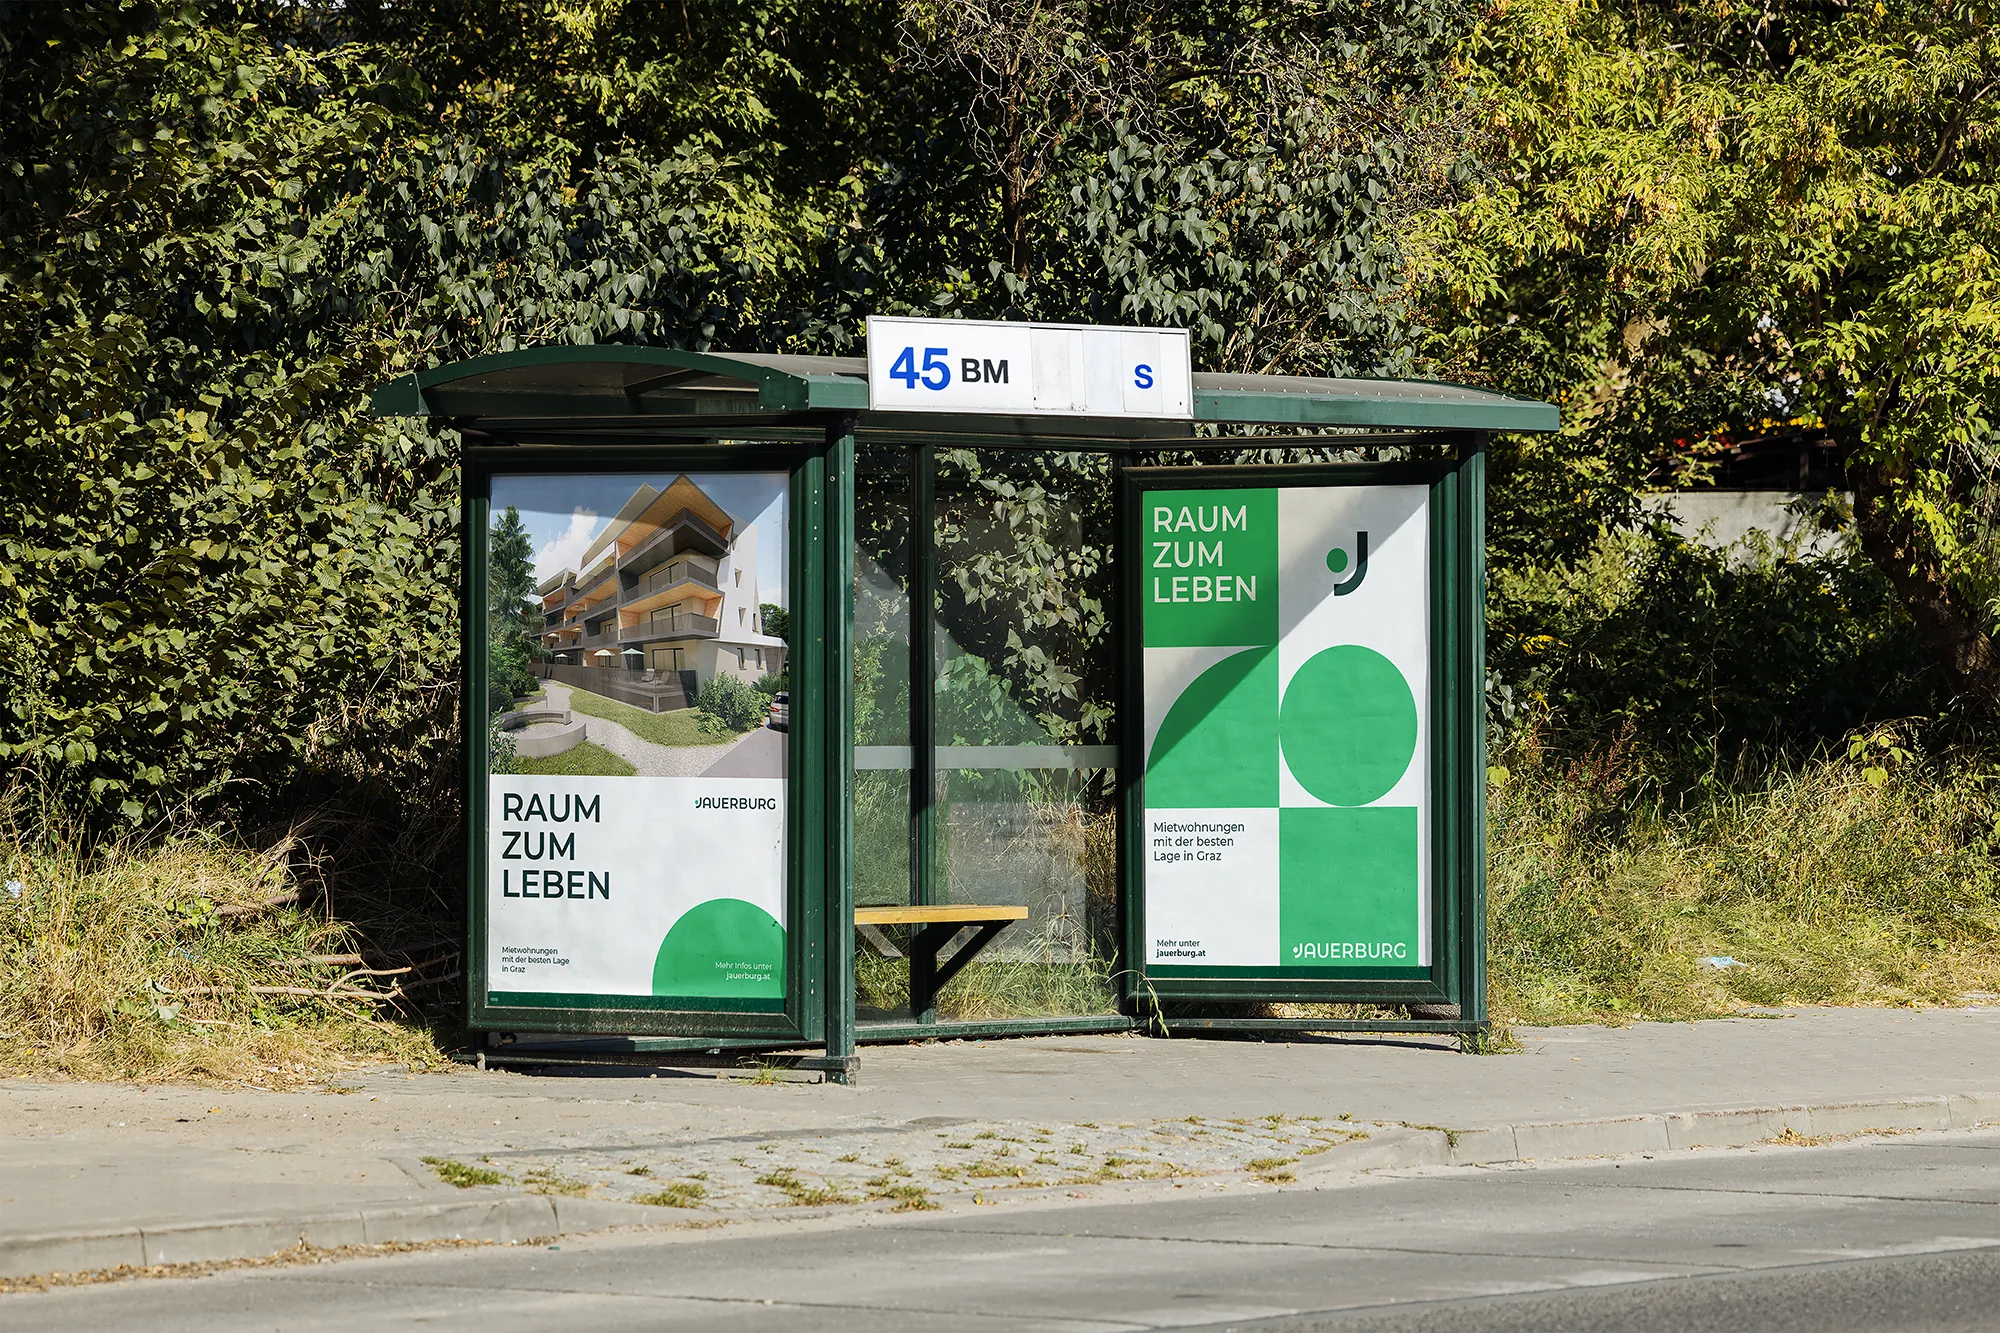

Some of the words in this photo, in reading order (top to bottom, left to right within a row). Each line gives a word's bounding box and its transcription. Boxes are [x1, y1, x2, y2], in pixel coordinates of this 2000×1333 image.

[889, 347, 951, 391] 45
[961, 358, 1009, 384] BM
[1134, 364, 1154, 390] S
[1153, 504, 1247, 533] RAUM
[1152, 540, 1223, 568] ZUM
[1154, 575, 1257, 603] LEBEN
[502, 792, 601, 823] RAUM
[694, 796, 777, 811] JAUERBURG
[1153, 821, 1245, 834] Mietwohnungen
[501, 831, 576, 861] ZUM
[1153, 835, 1173, 847] mit
[1174, 835, 1194, 847] der
[1196, 835, 1234, 847] besten
[1153, 850, 1181, 863] Lage
[1183, 849, 1194, 861] in
[1196, 850, 1222, 861] Graz
[502, 869, 611, 900] LEBEN
[1156, 938, 1177, 948] Mehr
[1178, 939, 1201, 948] unter
[501, 946, 559, 956] Mietwohnungen
[1155, 948, 1207, 959] jauerburg.at
[1292, 942, 1407, 960] JAUERBURG
[501, 955, 514, 963] mit
[515, 955, 527, 964] der
[528, 956, 551, 964] besten
[552, 957, 570, 967] Lage
[501, 965, 509, 973] in
[726, 971, 771, 981] jauerburg.at
